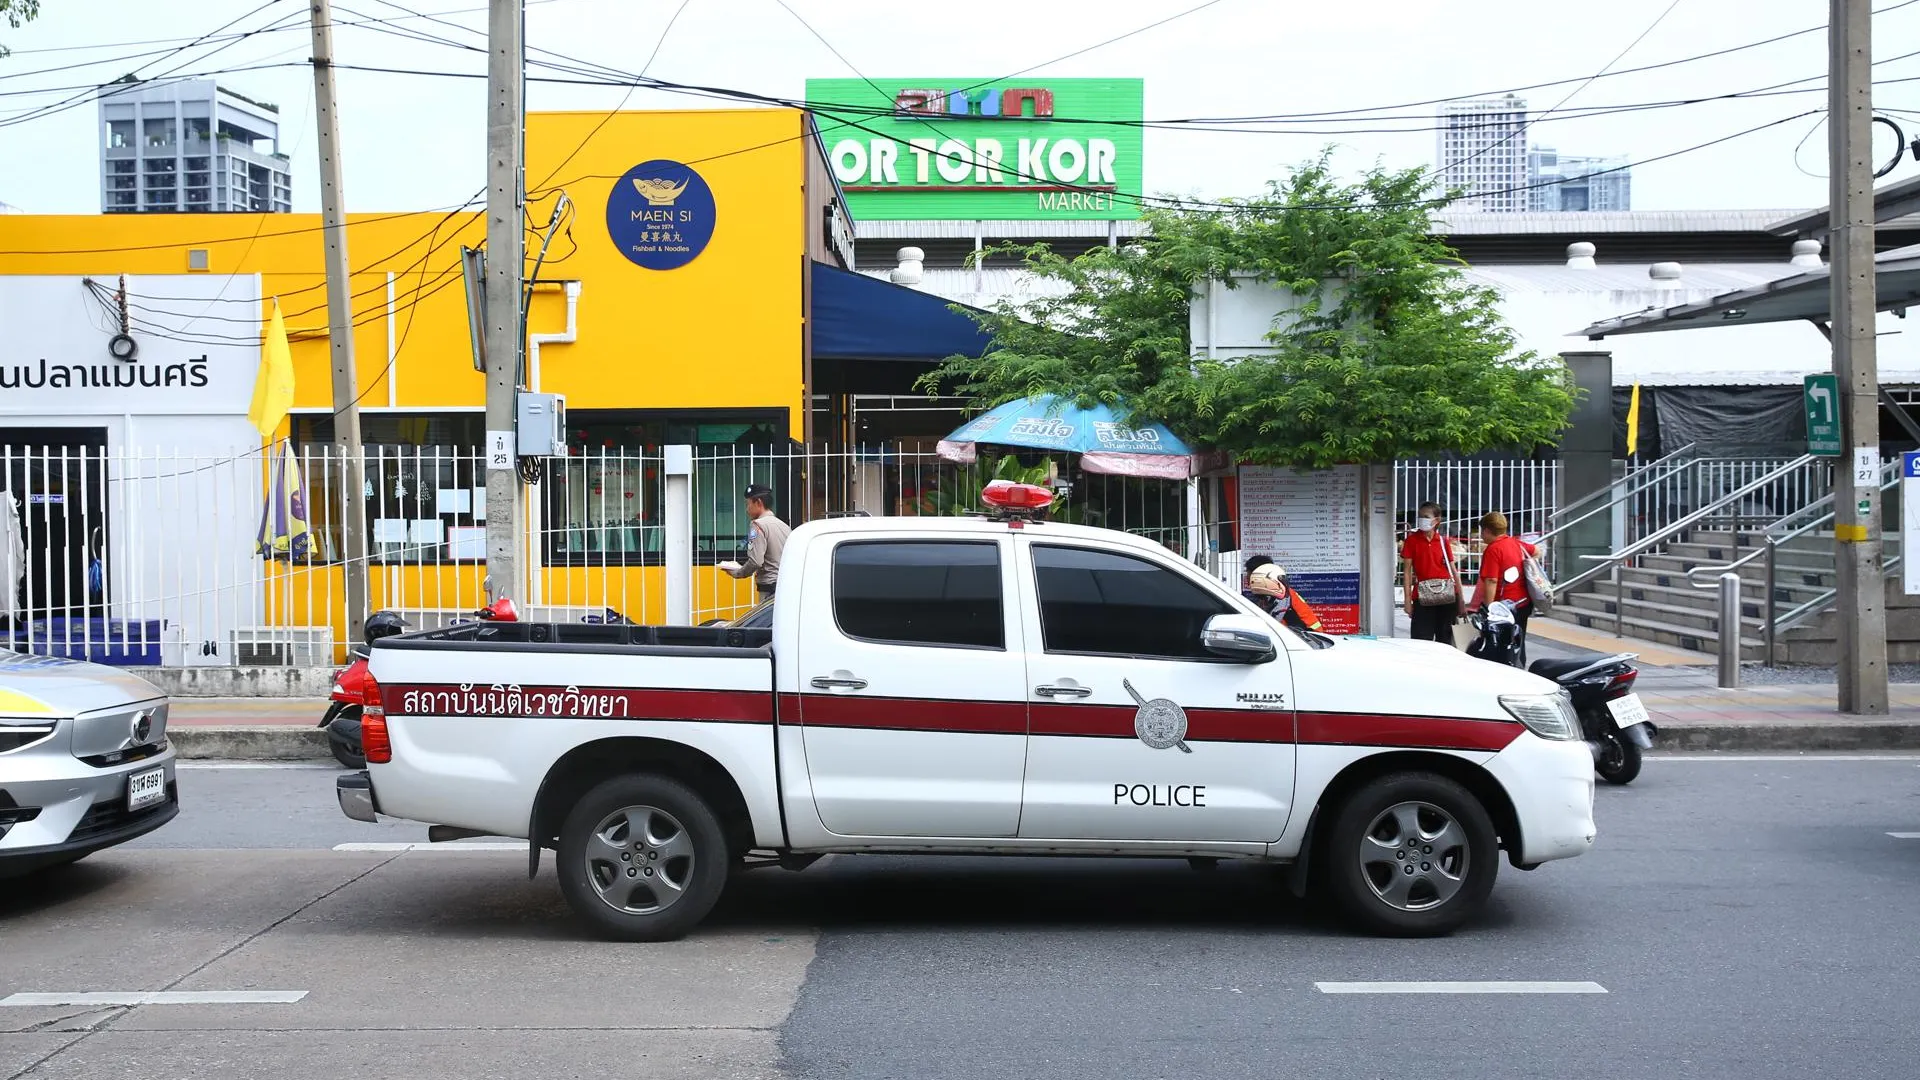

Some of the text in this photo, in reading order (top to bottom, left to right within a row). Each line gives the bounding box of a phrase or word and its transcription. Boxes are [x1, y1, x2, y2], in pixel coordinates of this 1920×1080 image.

[830, 139, 1116, 183] OR TOR KOR
[1038, 191, 1115, 211] MARKET
[631, 210, 691, 222] MAEN SI
[494, 454, 507, 464] 25
[1859, 470, 1873, 480] 27
[403, 683, 629, 717] สถาบันนิติเวชวิทยา
[1236, 692, 1284, 703] HILUX
[147, 773, 161, 789] 6991
[1114, 784, 1206, 807] POLICE
